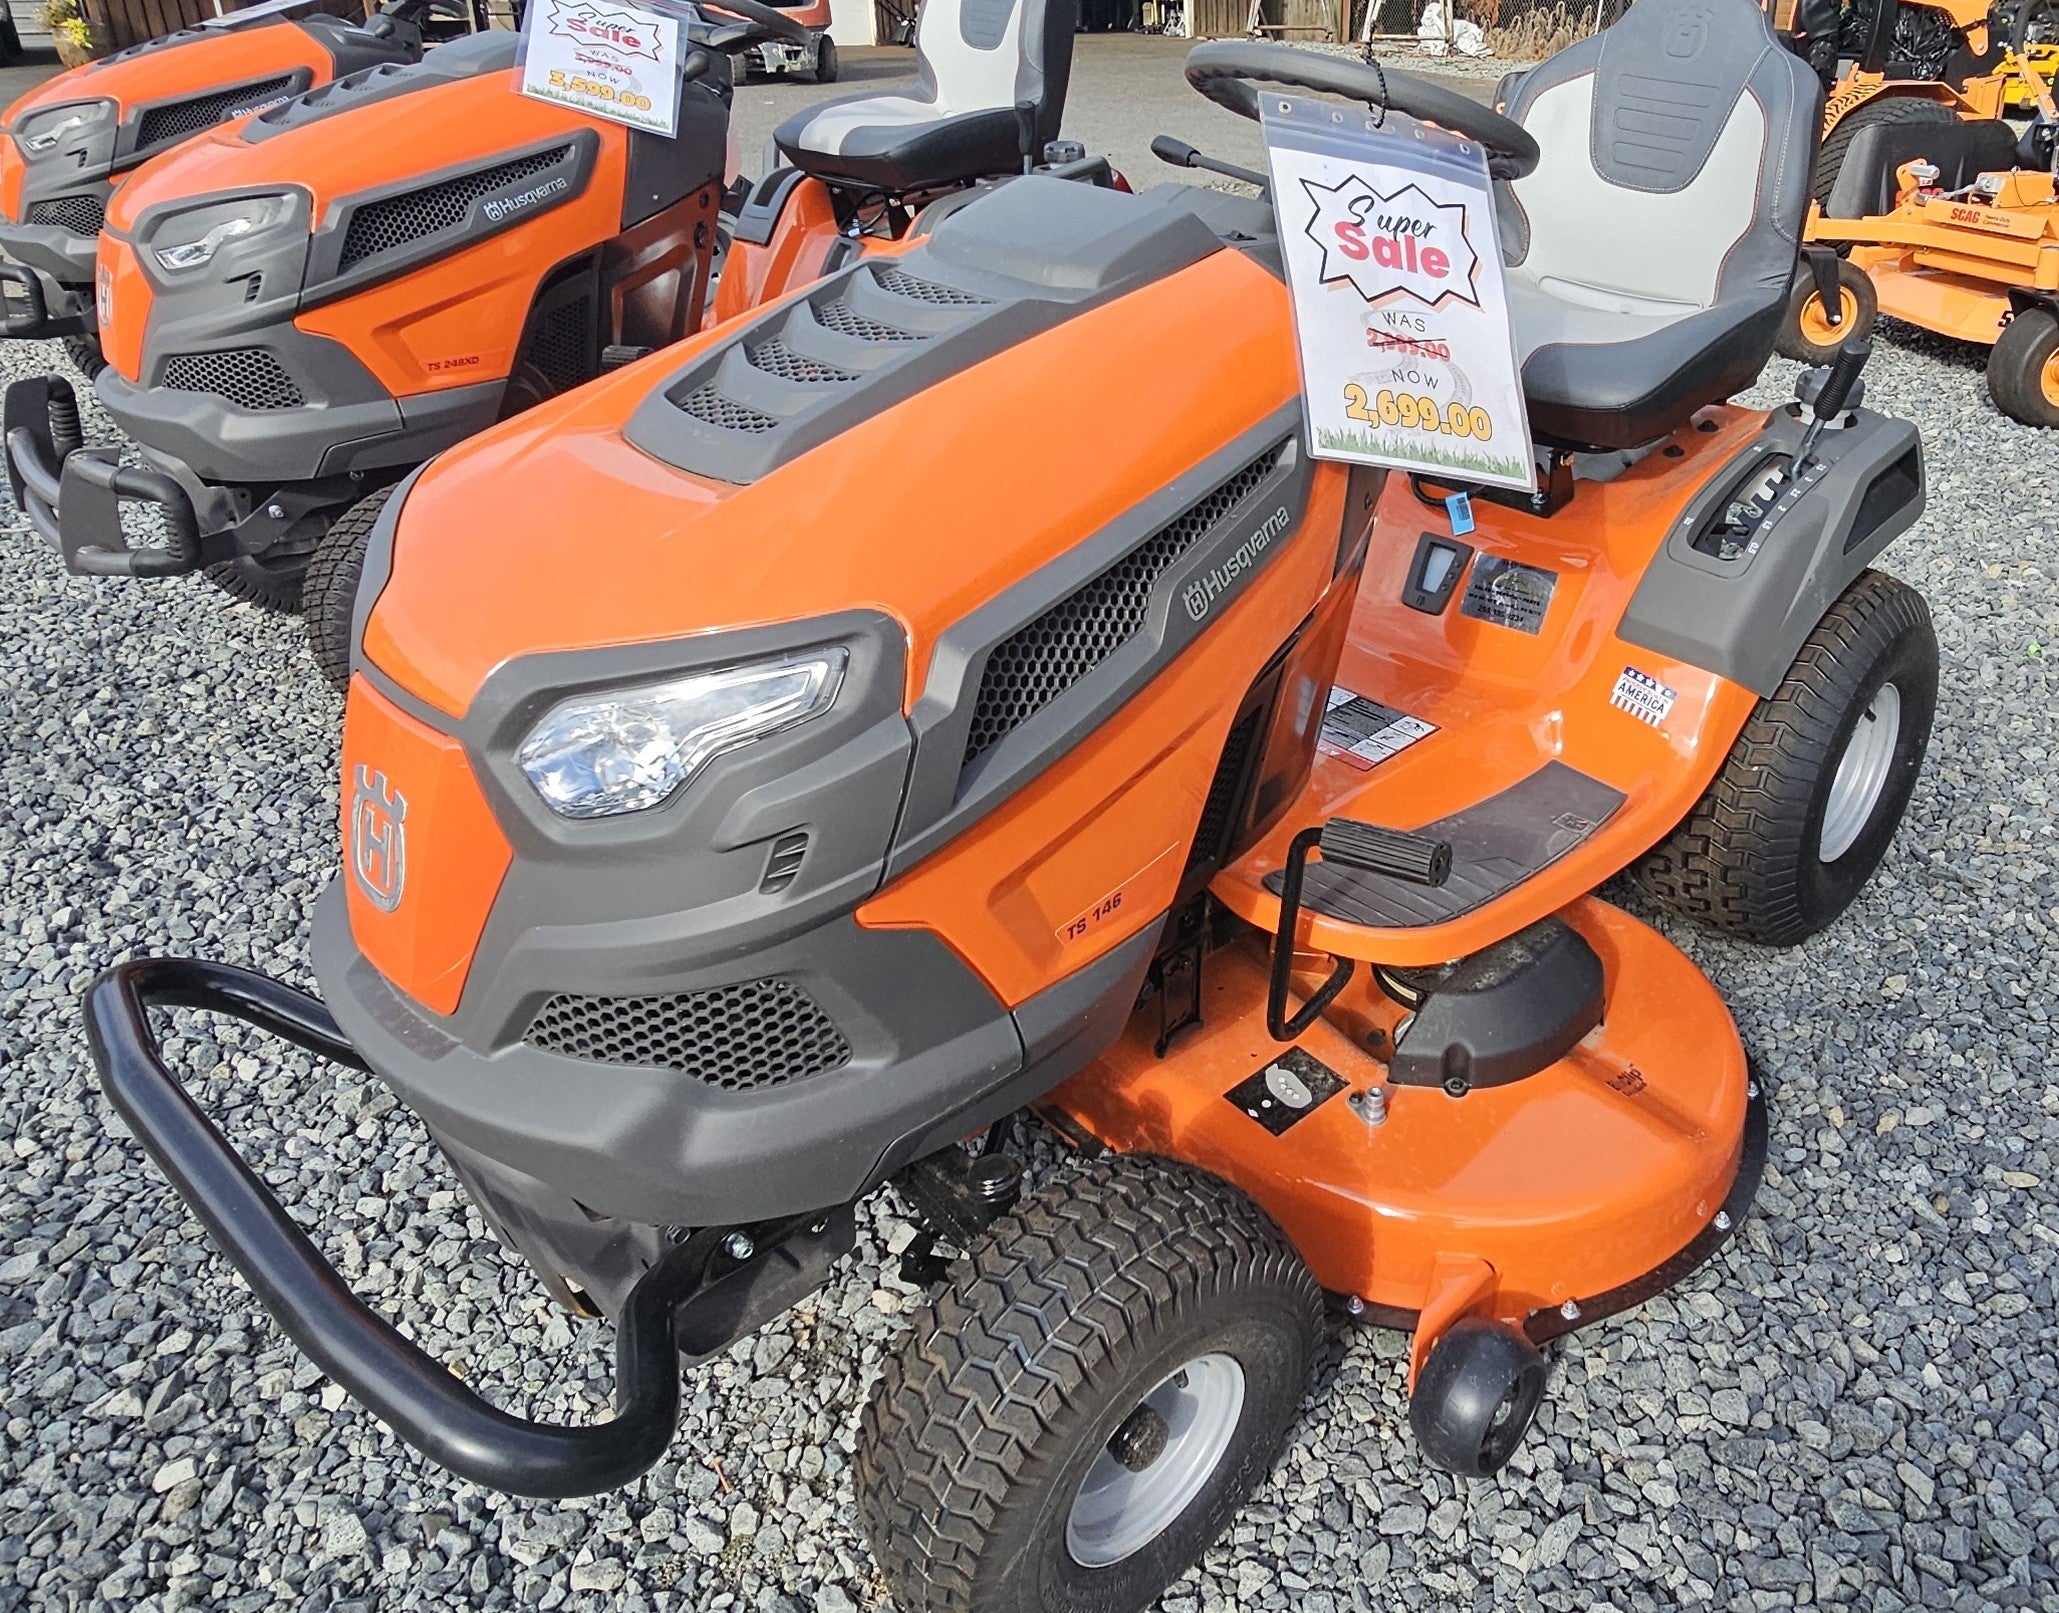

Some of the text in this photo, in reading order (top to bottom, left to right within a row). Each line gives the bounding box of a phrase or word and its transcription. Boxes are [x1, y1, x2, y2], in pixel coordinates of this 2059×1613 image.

[566, 17, 641, 48] Sale
[577, 12, 637, 34] Super
[590, 50, 619, 63] WAS
[549, 70, 652, 111] 3,599.00
[587, 70, 620, 84] NOW
[498, 177, 568, 214] Husqvarna
[1347, 194, 1438, 243] Super
[1951, 207, 1980, 224] SCAG
[1334, 220, 1450, 279] Sale
[1382, 311, 1427, 333] WAS
[427, 356, 480, 371] TS 248XD
[1391, 369, 1440, 390] NOW
[1343, 383, 1493, 442] 2,699.00
[1202, 505, 1290, 602] Husqvarna
[1618, 682, 1665, 714] AMERICA
[1067, 892, 1122, 940] TS 146
